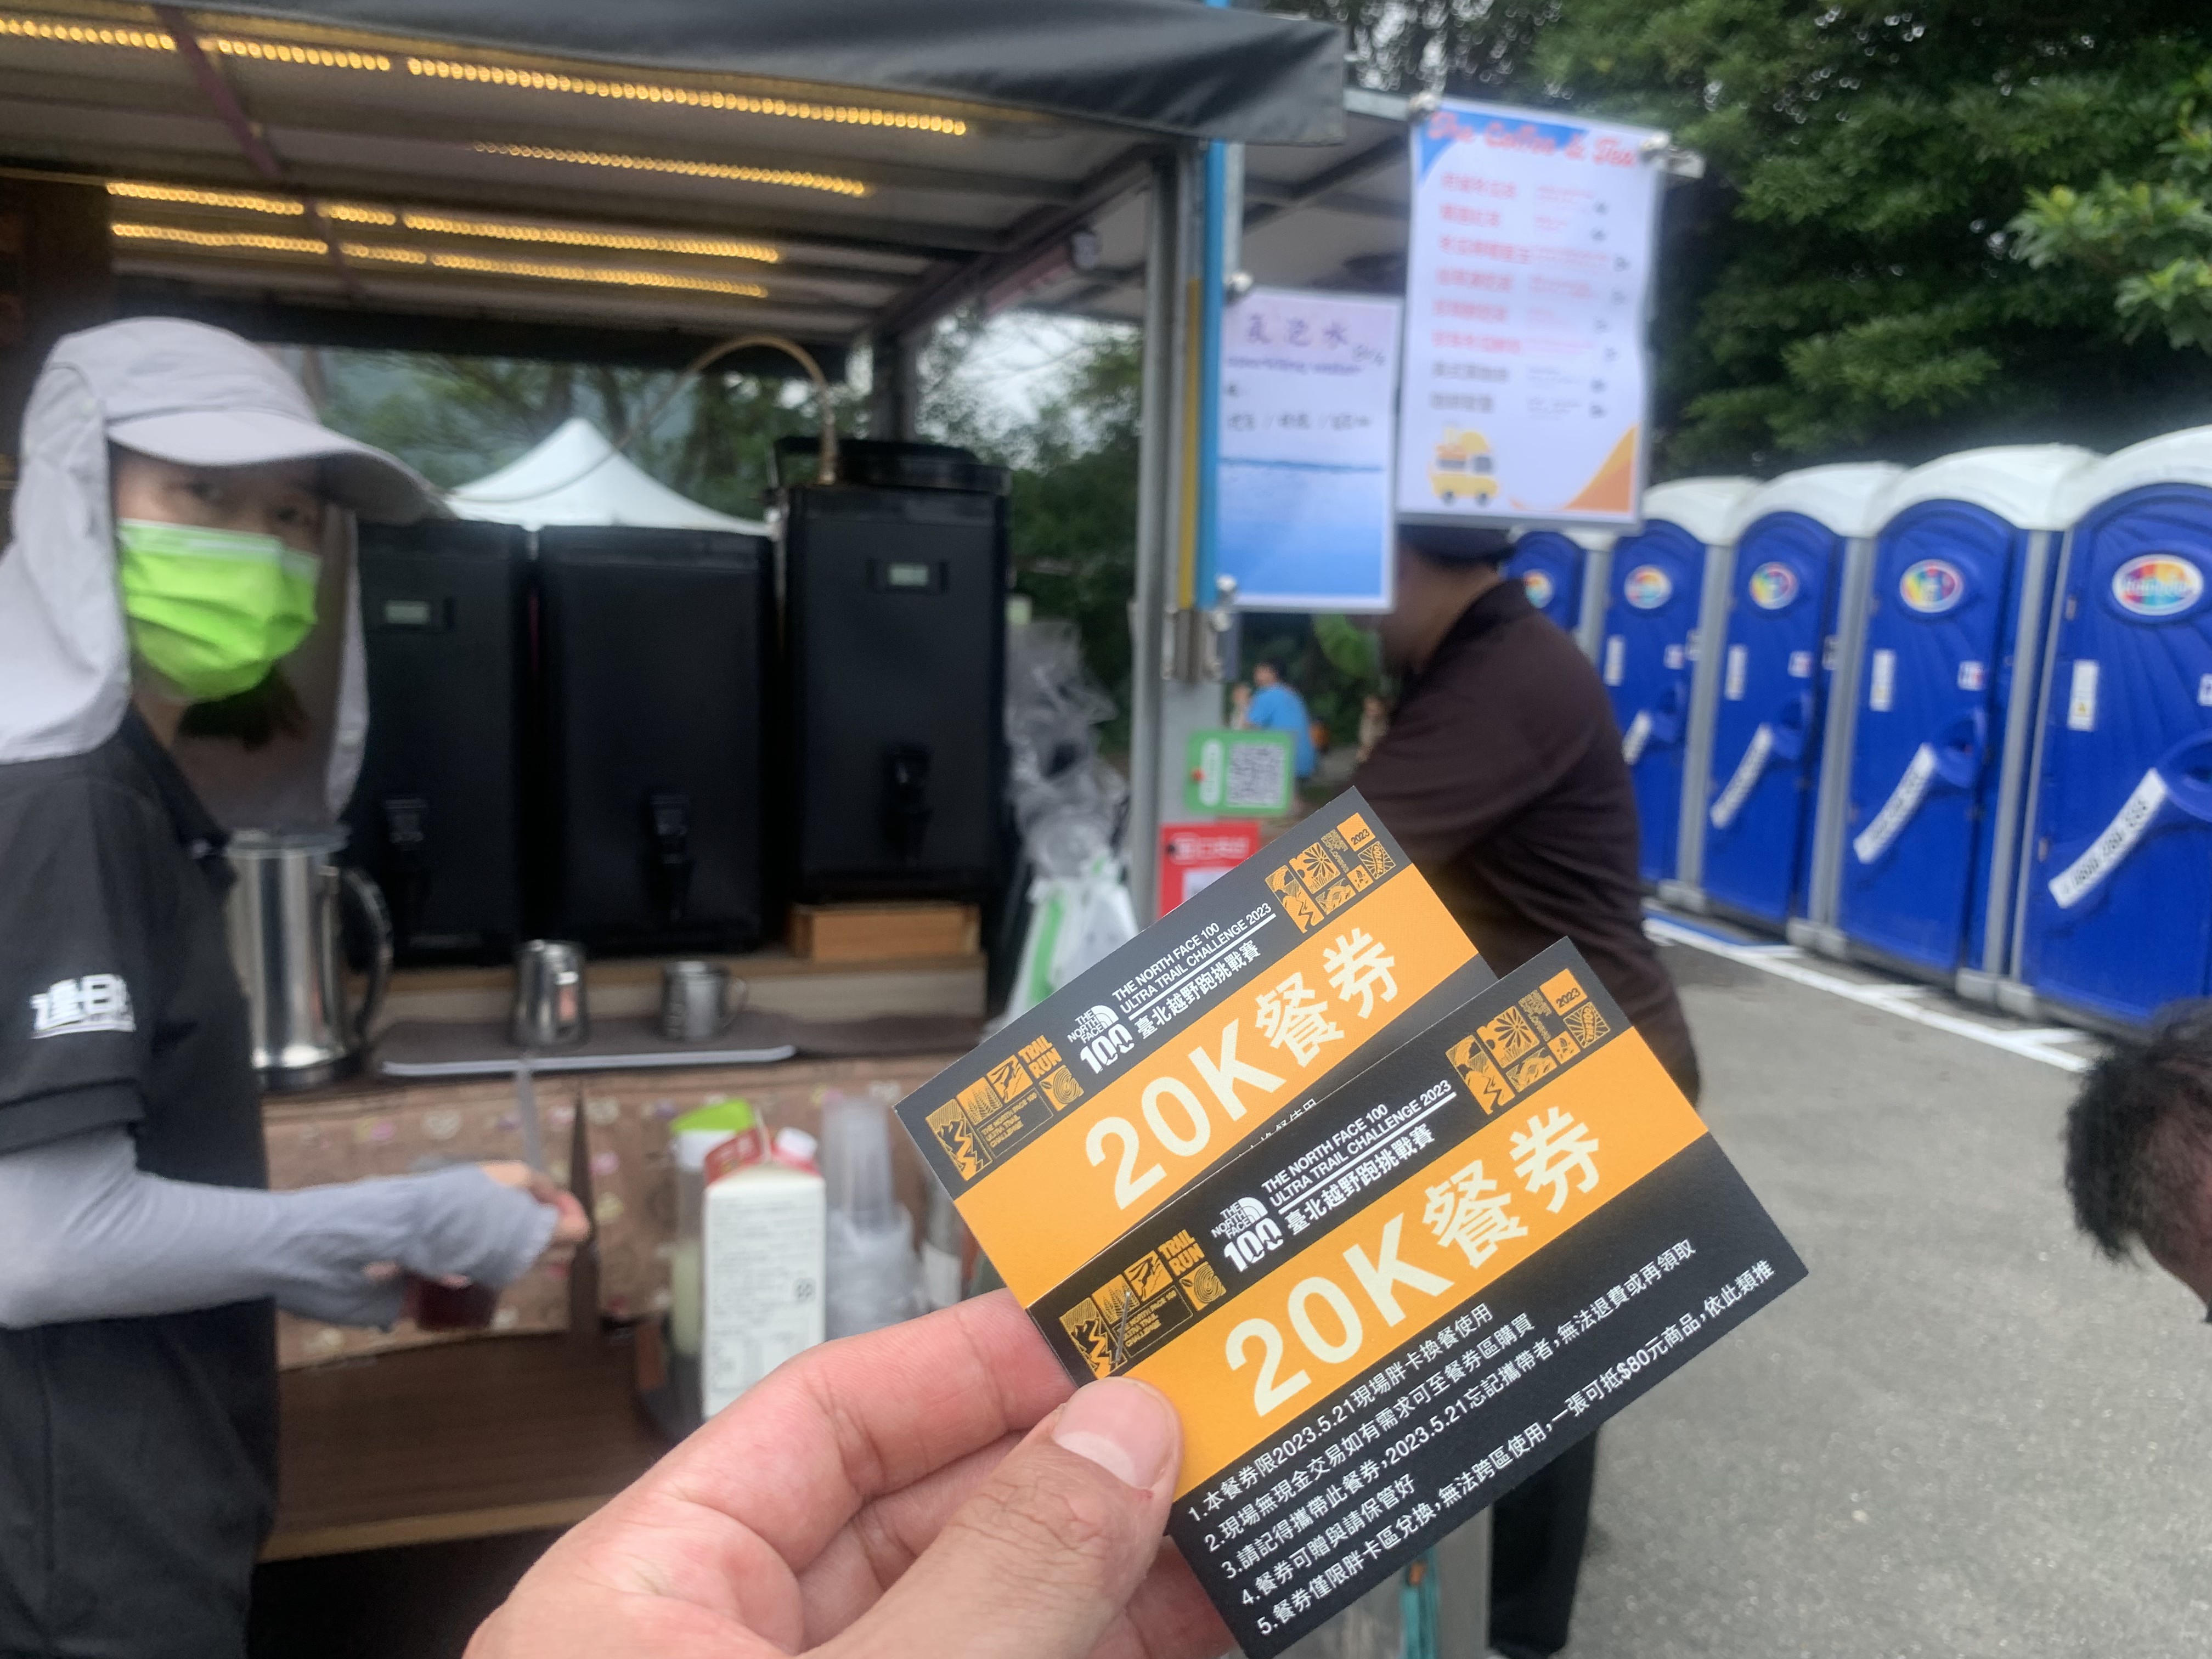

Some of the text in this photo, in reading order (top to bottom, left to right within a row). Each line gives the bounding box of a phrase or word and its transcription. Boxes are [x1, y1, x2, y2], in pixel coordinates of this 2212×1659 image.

[1351, 829, 1370, 845] 2023
[1112, 923, 1219, 1001] THE NORTH FACE 100
[1120, 903, 1271, 1013] ULTRA TRAIL CHALLENGE 2023
[1135, 940, 1260, 1039] 臺北越野跑挑戰賽
[1556, 988, 1581, 1008] 2023
[1068, 1017, 1101, 1042] NORTH
[1075, 1008, 1095, 1025] THE
[1081, 1023, 1105, 1043] FACE
[1019, 1036, 1052, 1063] TRAIL
[1029, 1049, 1061, 1077] RUN
[1080, 1024, 1134, 1074] 100
[1262, 1170, 1290, 1193] THE
[1288, 1141, 1334, 1176] NORTH
[1332, 1118, 1367, 1147] FACE
[1366, 1104, 1387, 1123] 100
[1270, 1175, 1313, 1206] ULTRA
[1310, 1152, 1348, 1178] TRAIL
[1347, 1099, 1421, 1154] CHALLENGE
[1420, 1080, 1451, 1106] 2023
[1285, 1124, 1435, 1235] 臺北越野跑挑戰賽
[1211, 1209, 1246, 1237] NORTH
[1220, 1202, 1242, 1220] THE
[1226, 1217, 1251, 1239] FACE
[1159, 1230, 1194, 1259] TRAIL
[1224, 1218, 1283, 1272] 100
[1170, 1244, 1204, 1274] RUN
